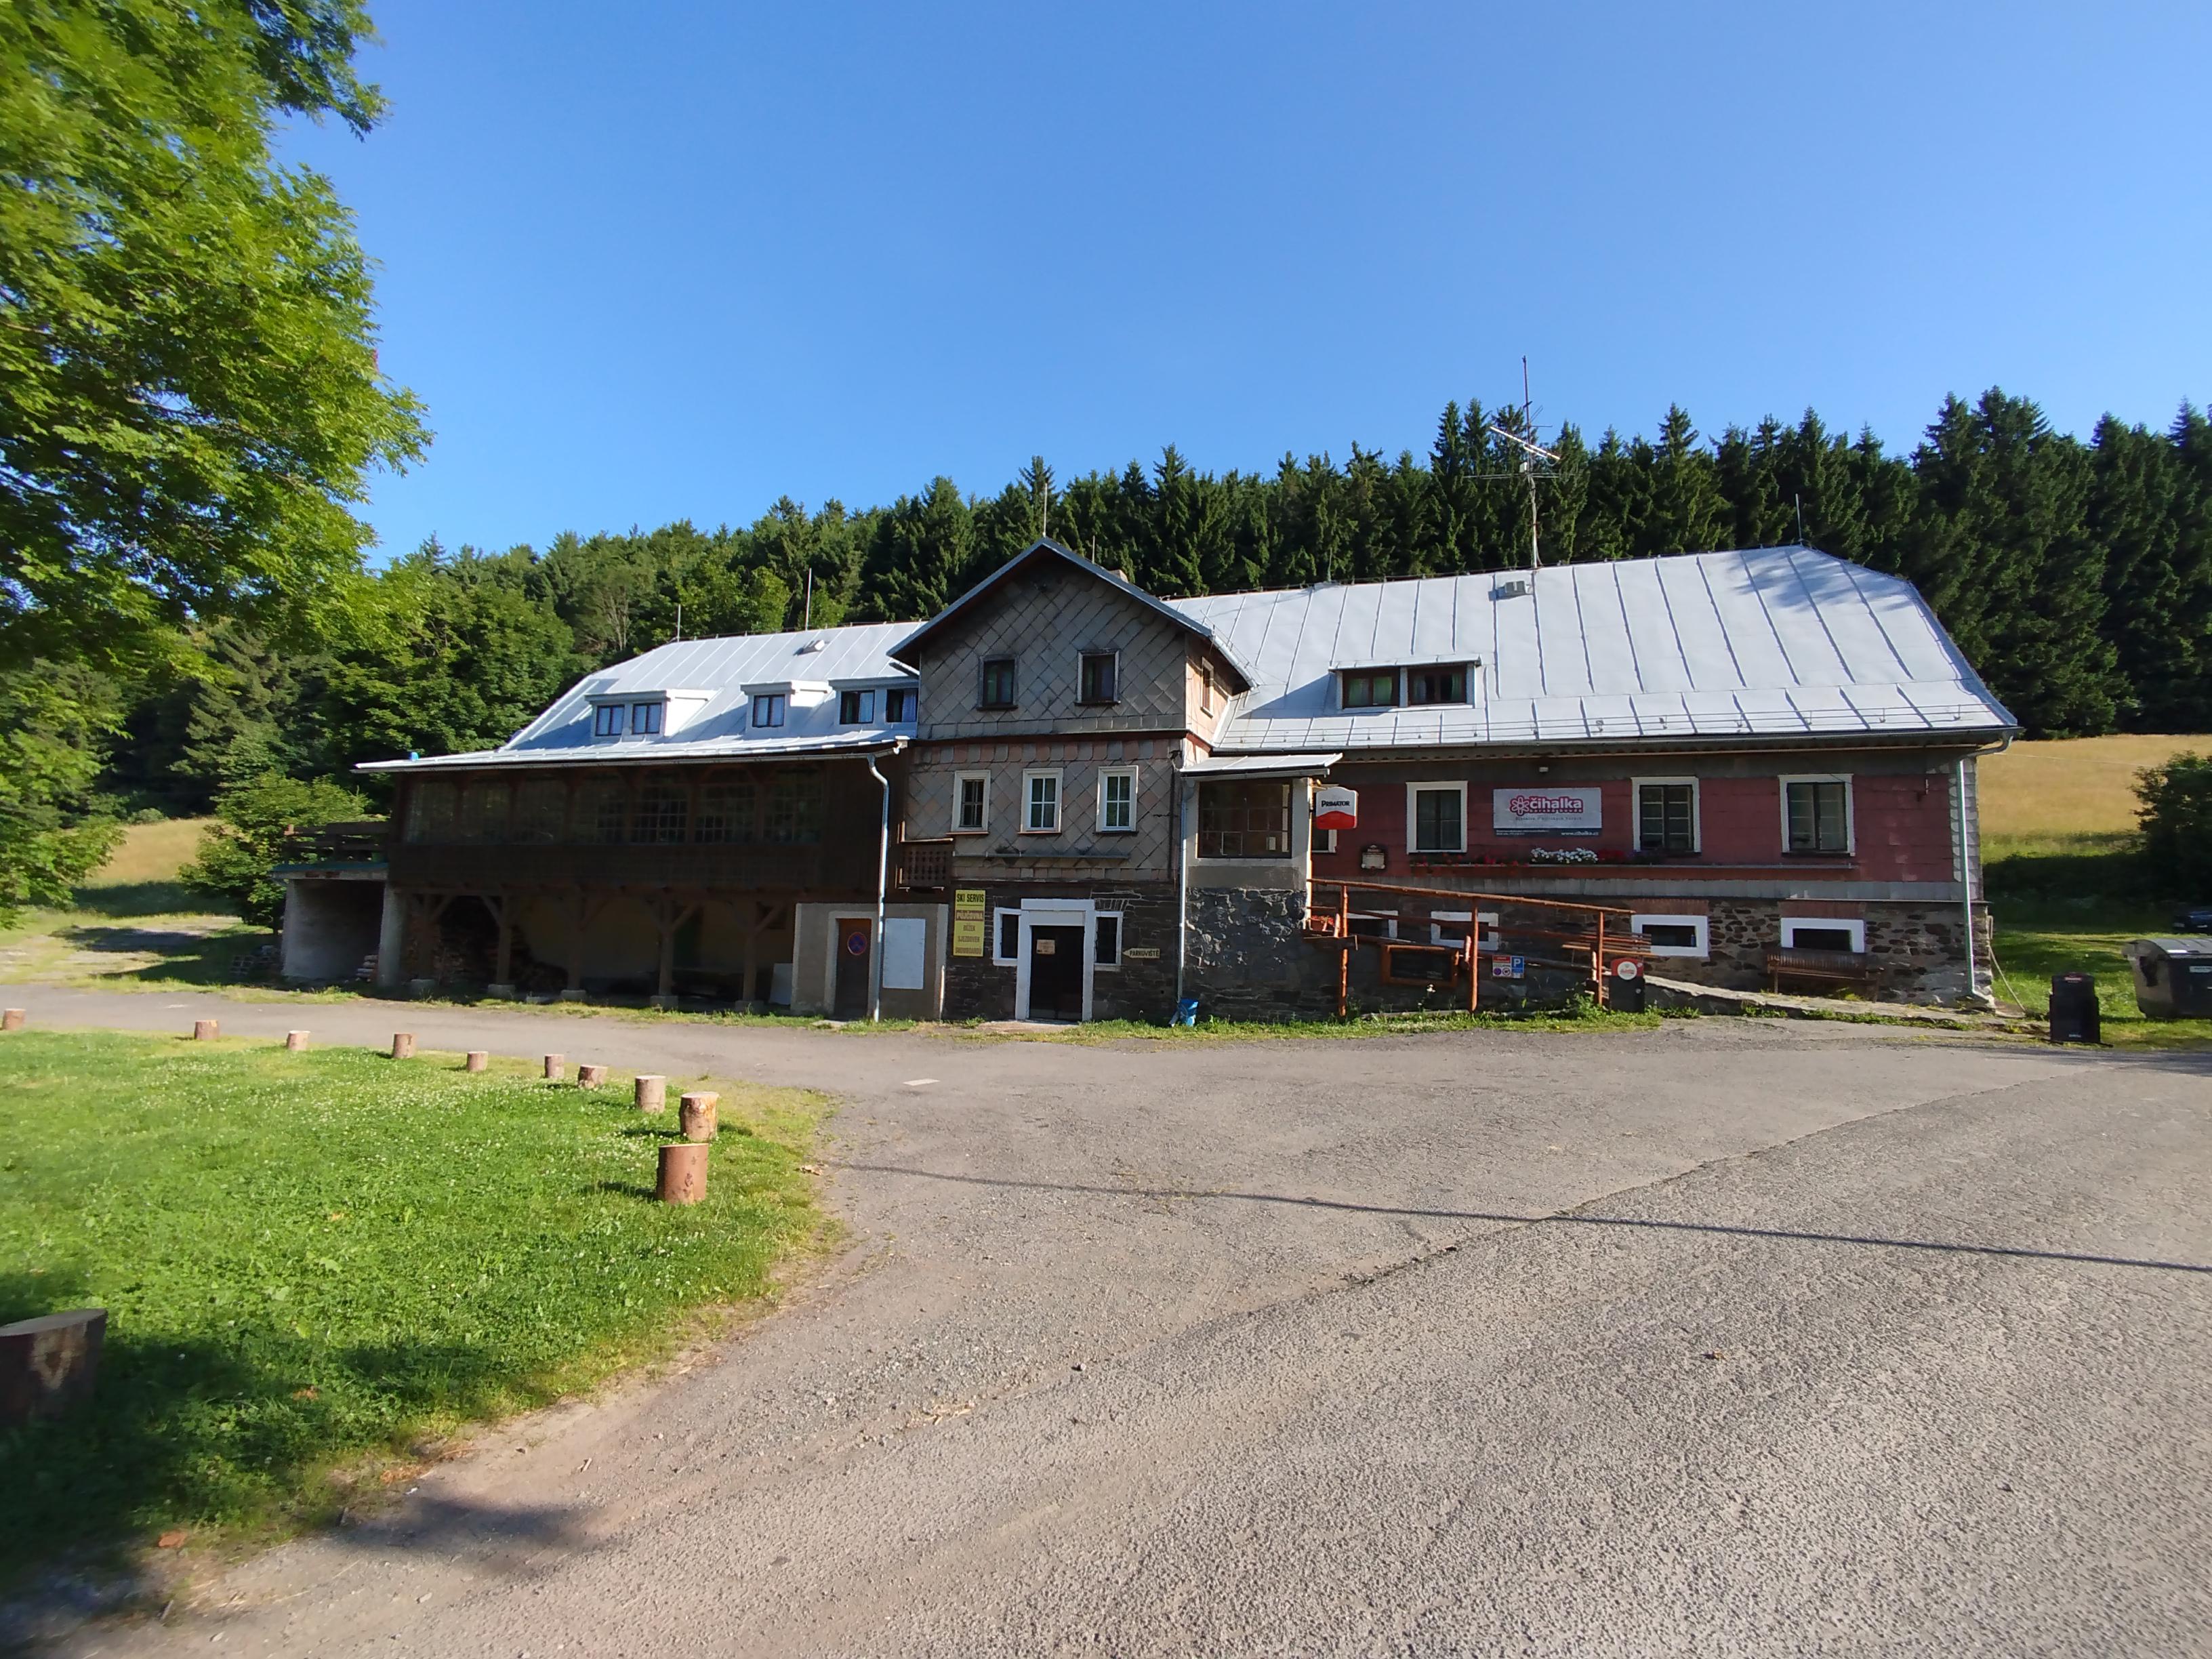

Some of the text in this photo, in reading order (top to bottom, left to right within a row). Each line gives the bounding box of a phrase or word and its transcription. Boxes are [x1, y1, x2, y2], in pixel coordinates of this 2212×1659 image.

[1530, 797, 1581, 808] čihalka
[956, 893, 985, 903] SKI SERVIS
